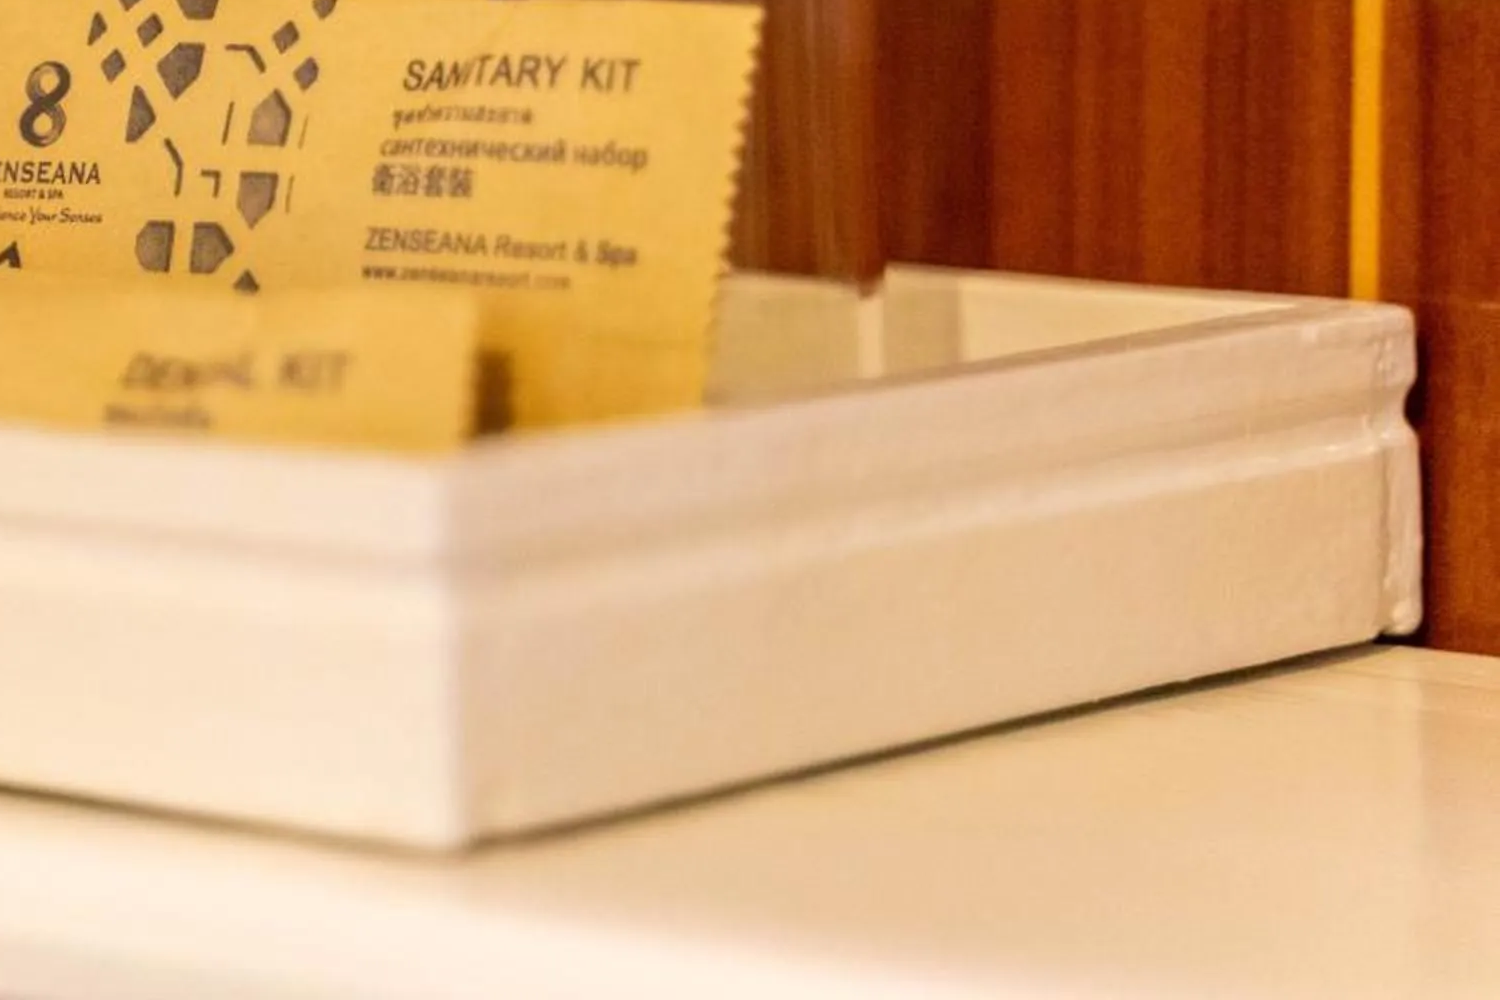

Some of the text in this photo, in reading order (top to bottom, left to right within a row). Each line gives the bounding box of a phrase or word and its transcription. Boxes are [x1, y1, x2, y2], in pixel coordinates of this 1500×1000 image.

[403, 54, 641, 93] SANITARY KIT
[19, 60, 71, 148] 8
[380, 137, 648, 174] сантехнический набор
[29, 206, 57, 225] Your
[58, 207, 104, 224] Senses
[365, 226, 639, 270] ZENSEANA Resort & Spa
